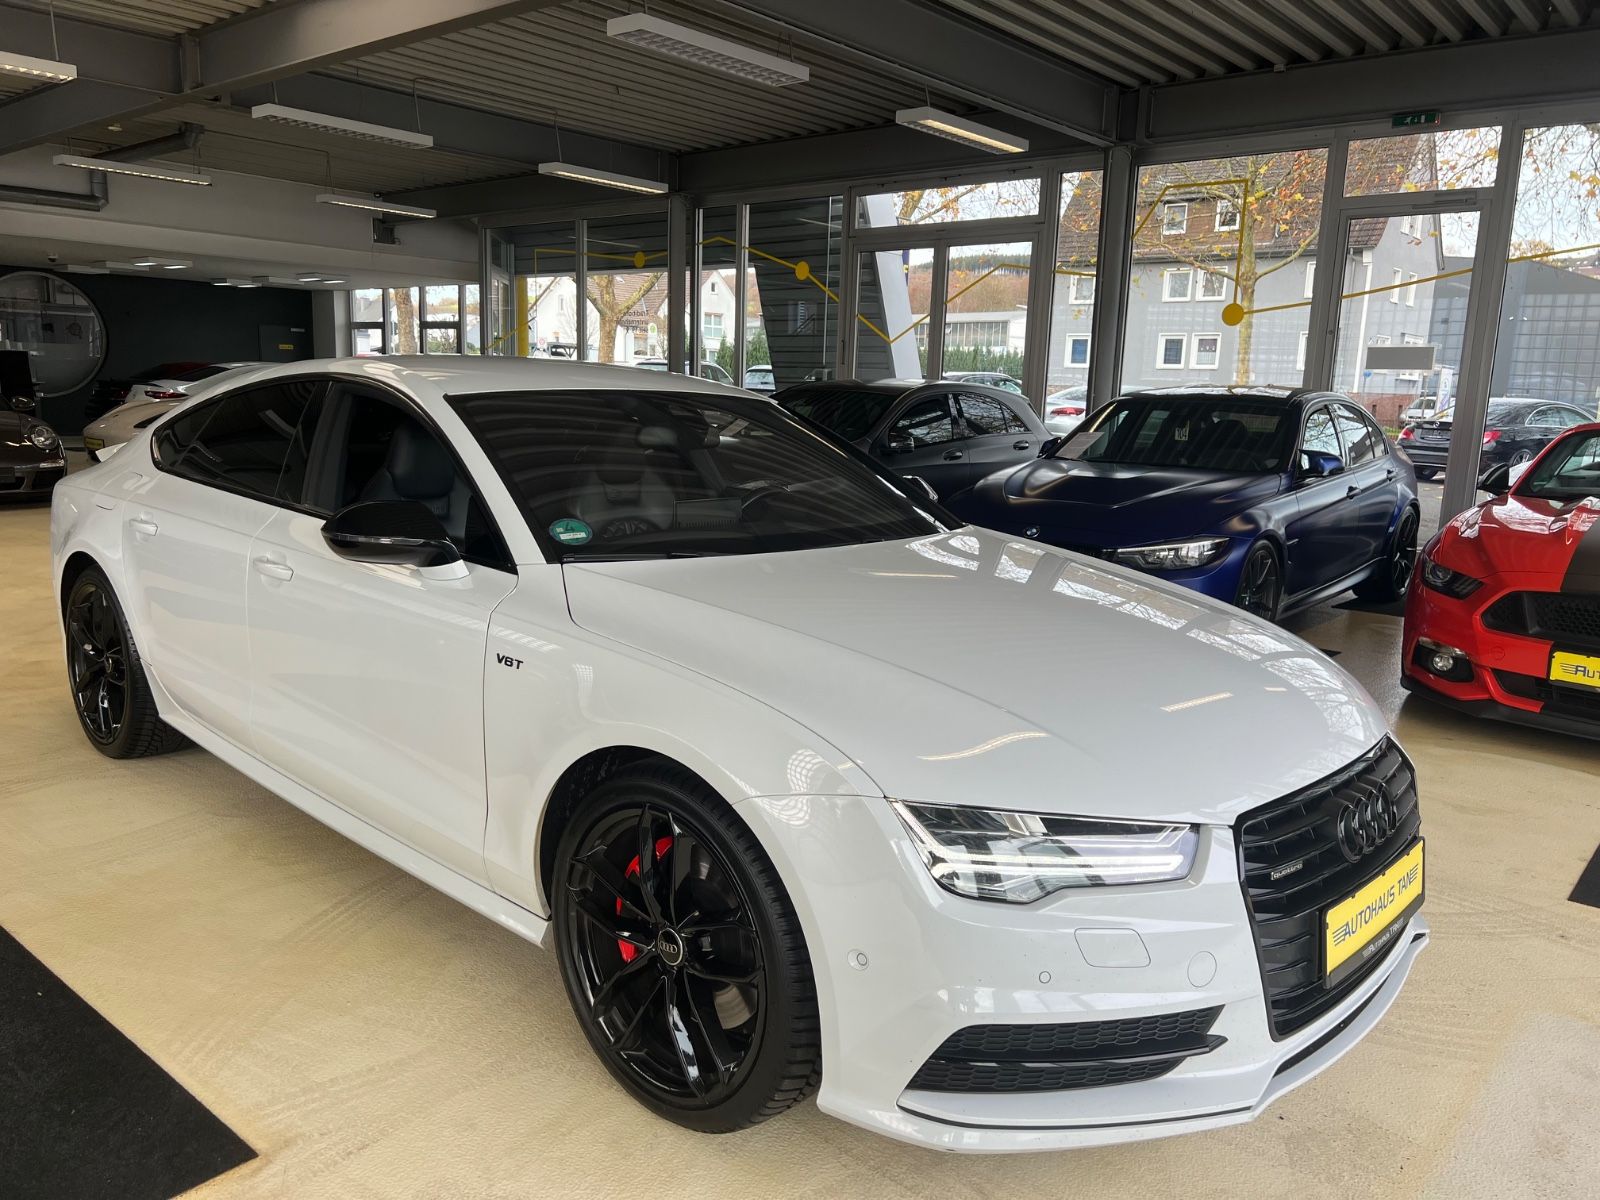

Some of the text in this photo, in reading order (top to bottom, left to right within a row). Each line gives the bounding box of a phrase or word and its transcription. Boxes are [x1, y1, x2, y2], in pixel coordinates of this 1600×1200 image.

[496, 652, 524, 670] V6T
[1273, 863, 1304, 880] quattro
[1343, 885, 1396, 942] AUTOHAUS
